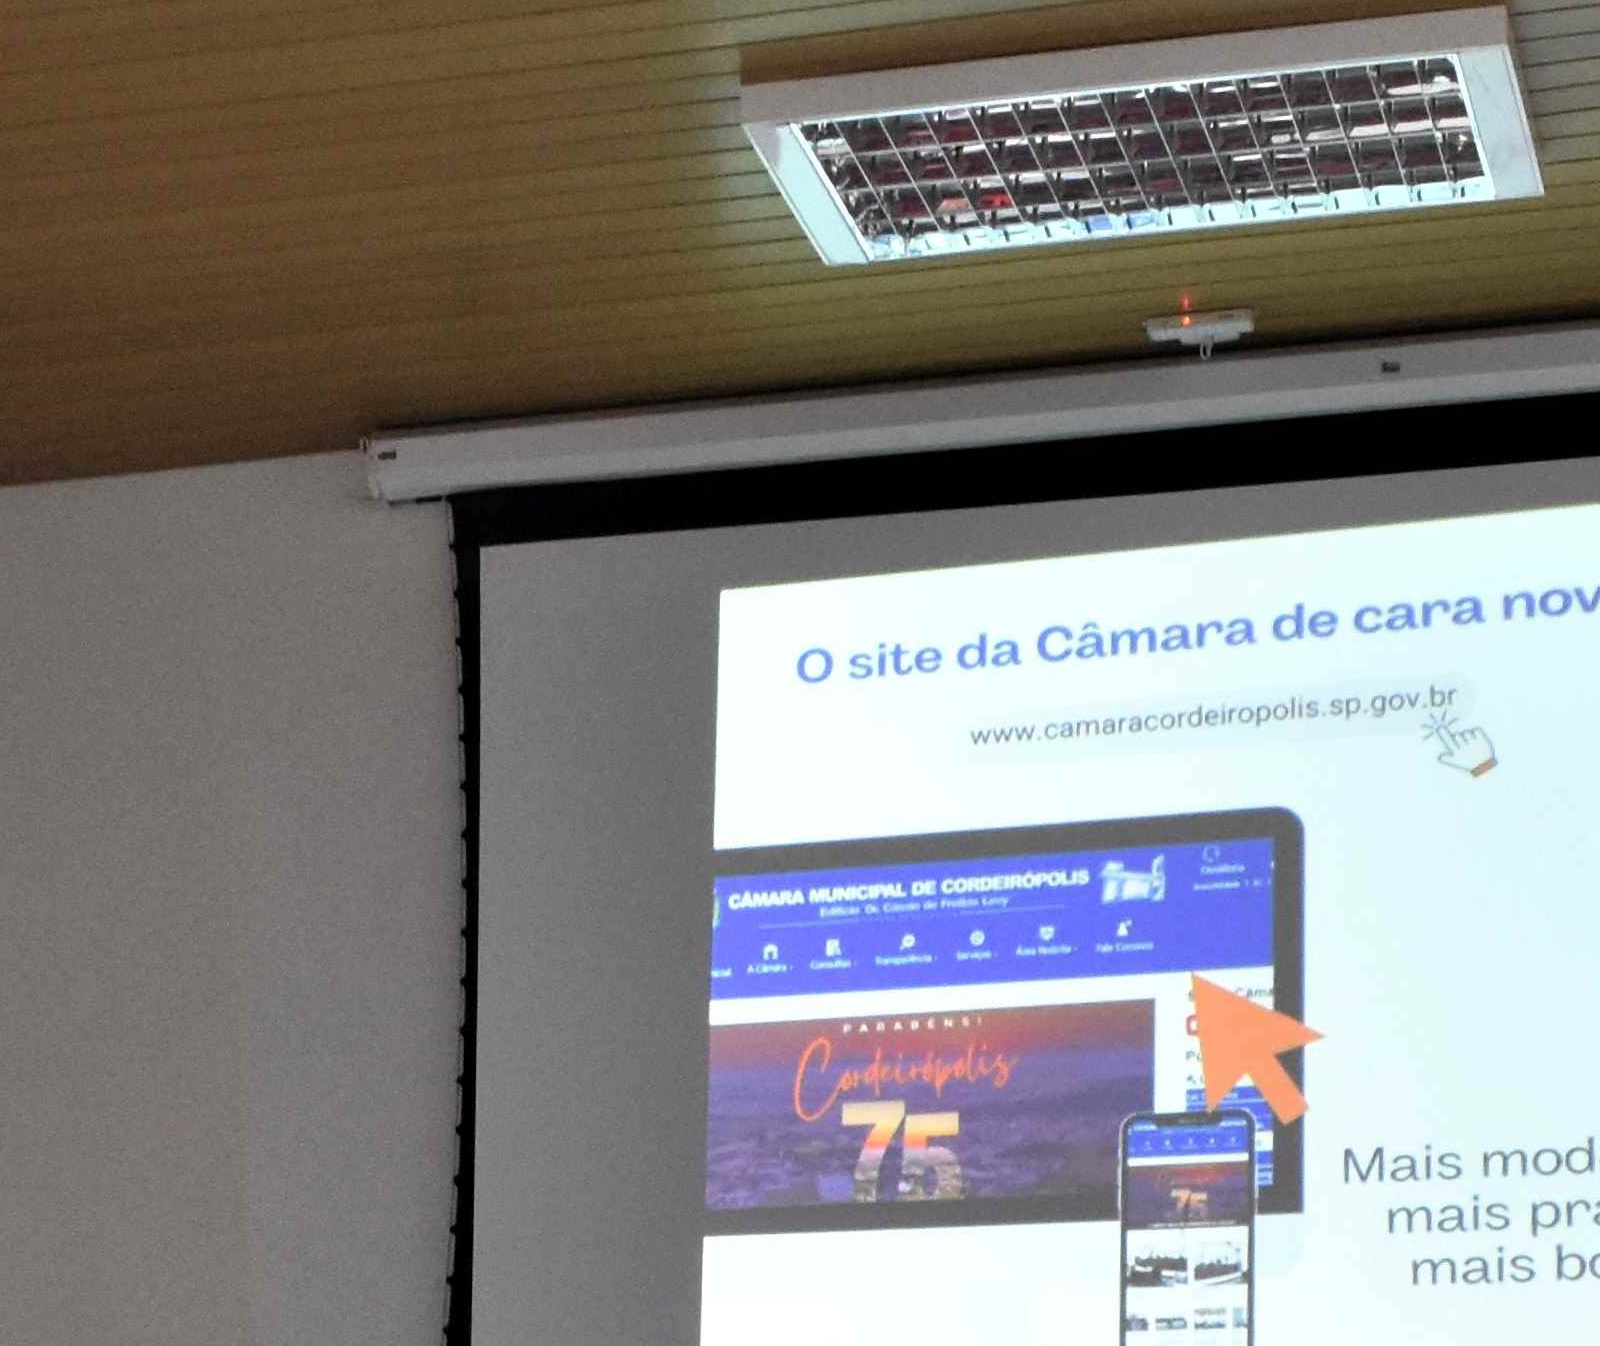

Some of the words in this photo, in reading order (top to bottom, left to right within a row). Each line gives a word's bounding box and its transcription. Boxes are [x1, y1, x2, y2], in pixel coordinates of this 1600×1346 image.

[796, 647, 834, 684] O
[847, 643, 943, 680] site
[956, 632, 1021, 670] da
[1036, 616, 1257, 663] Câmara
[1272, 602, 1339, 641] de
[1353, 595, 1486, 634] cara
[969, 684, 1457, 746] www.camaracordeiropolis.sp.gov.br
[727, 888, 805, 910] CÂMARA
[808, 882, 907, 904] MUNICIPAL
[911, 879, 938, 897] DE
[940, 868, 1091, 895] CORDEIRÓPOLIS
[841, 1100, 964, 1202] 75
[1342, 1144, 1463, 1184] Mais
[1386, 1194, 1511, 1234] mais
[1411, 1246, 1536, 1286] mais
